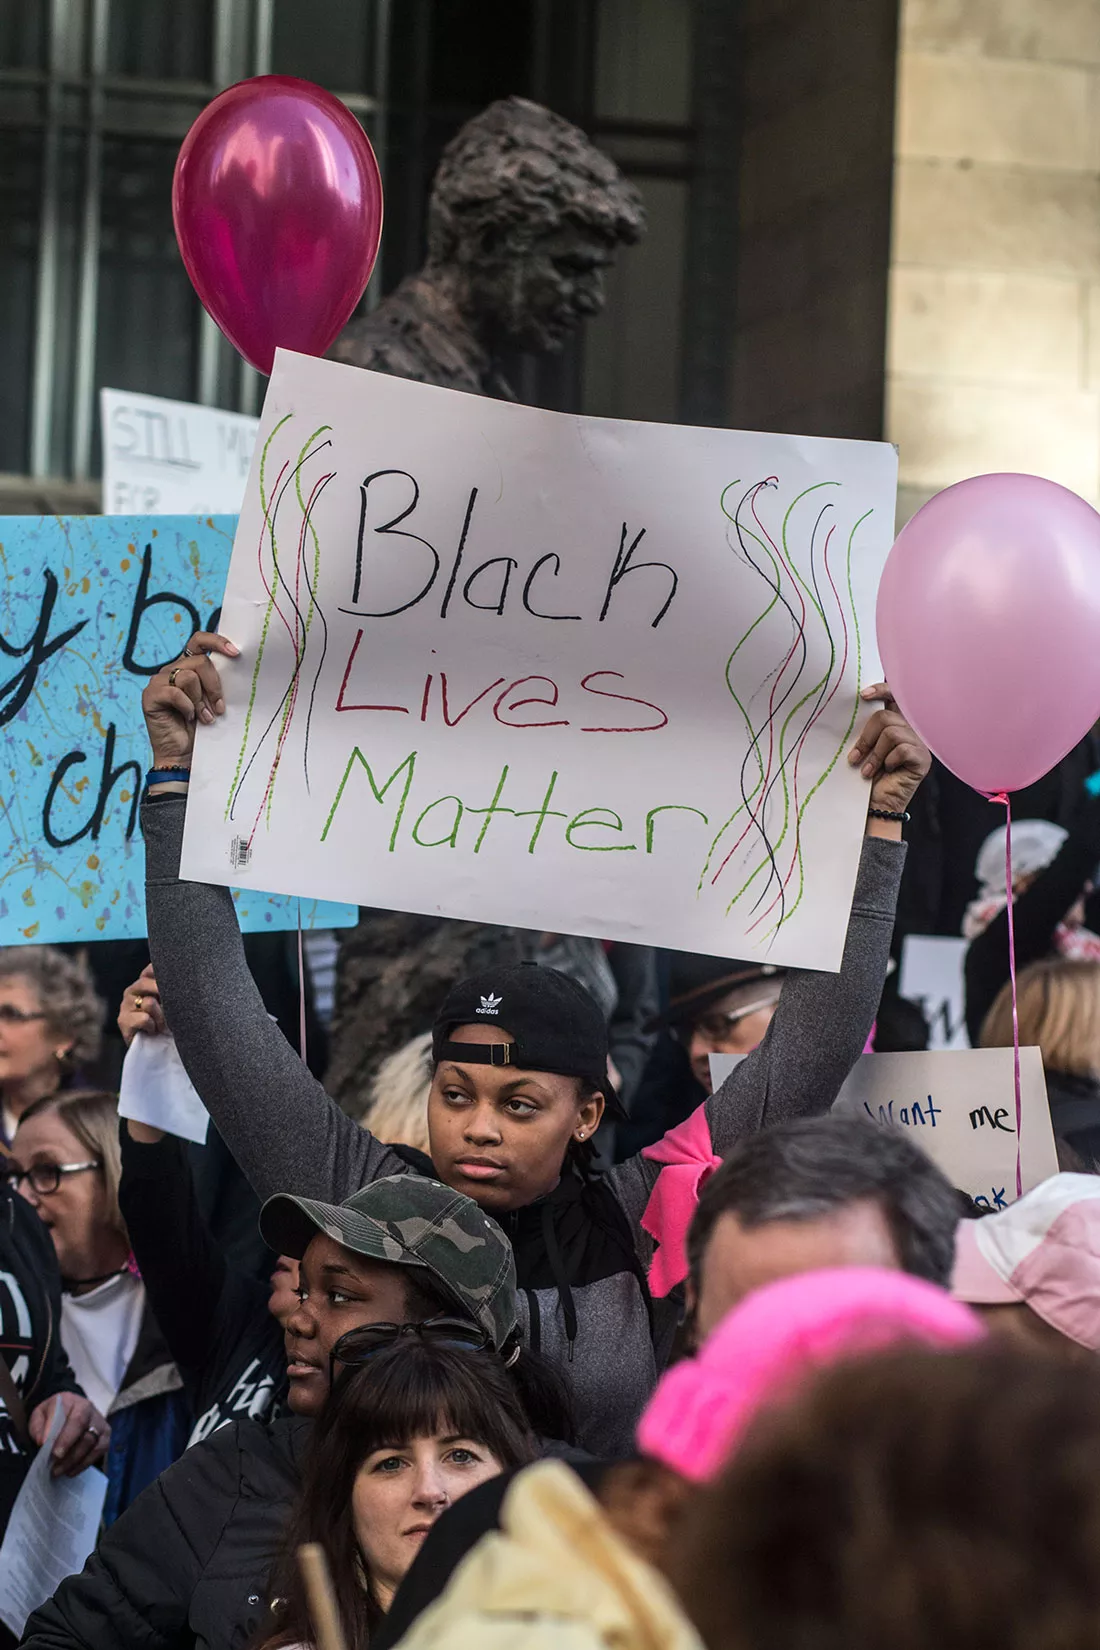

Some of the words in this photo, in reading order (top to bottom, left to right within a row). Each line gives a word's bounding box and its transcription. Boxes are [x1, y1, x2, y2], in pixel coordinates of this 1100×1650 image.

[338, 469, 679, 628] Black
[122, 543, 222, 676] b
[335, 628, 669, 733] Lives
[319, 746, 709, 854] Matter
[475, 1007, 499, 1015] adidas
[969, 1105, 1016, 1133] me
